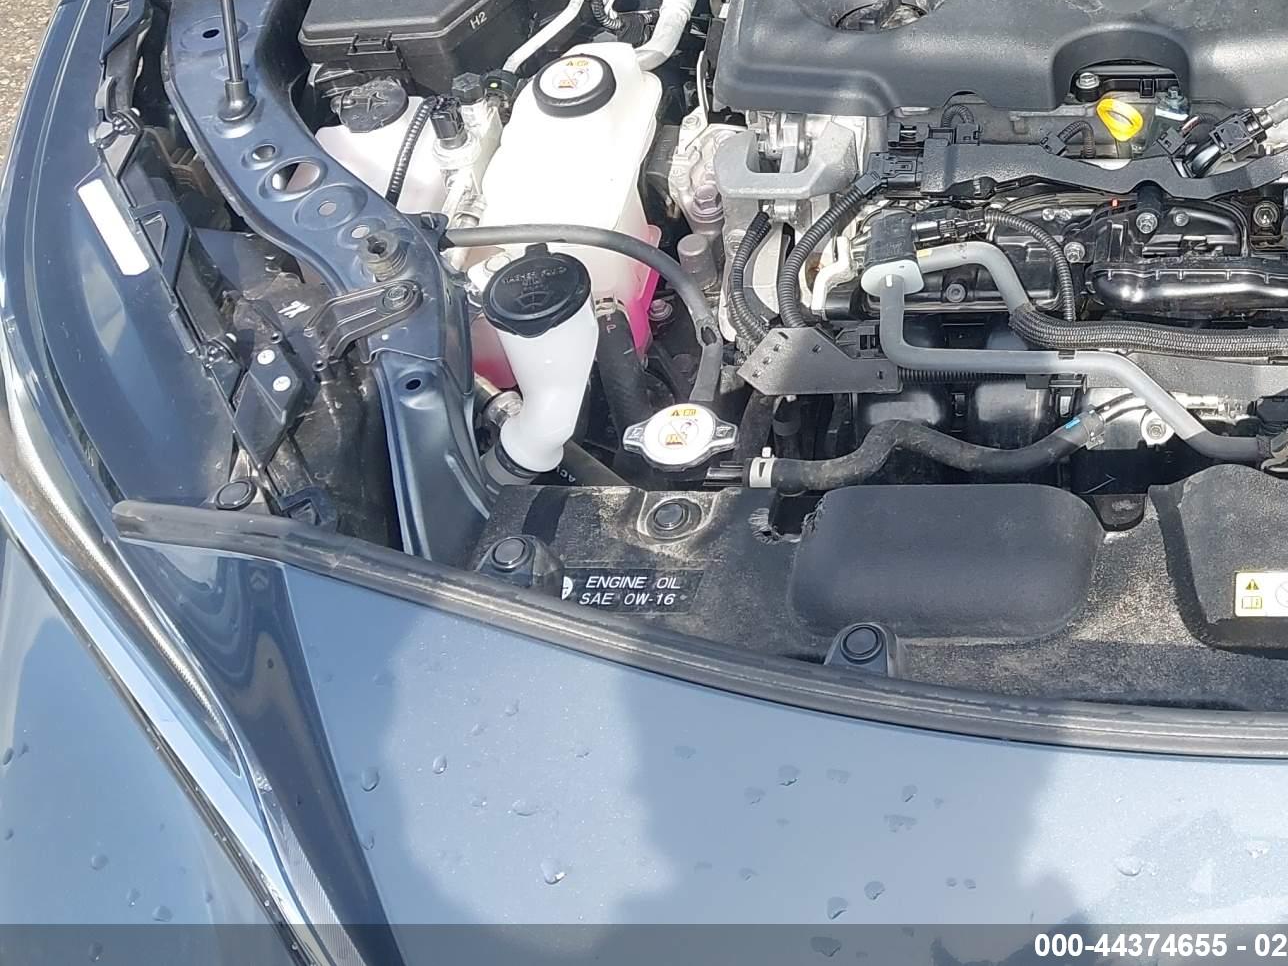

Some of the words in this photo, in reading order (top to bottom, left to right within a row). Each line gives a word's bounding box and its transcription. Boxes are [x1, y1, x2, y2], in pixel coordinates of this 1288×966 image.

[470, 11, 488, 30] H2
[585, 576, 648, 589] ENGINE
[656, 577, 681, 590] OIL
[579, 592, 615, 605] SAE
[624, 593, 677, 605] 0W-16
